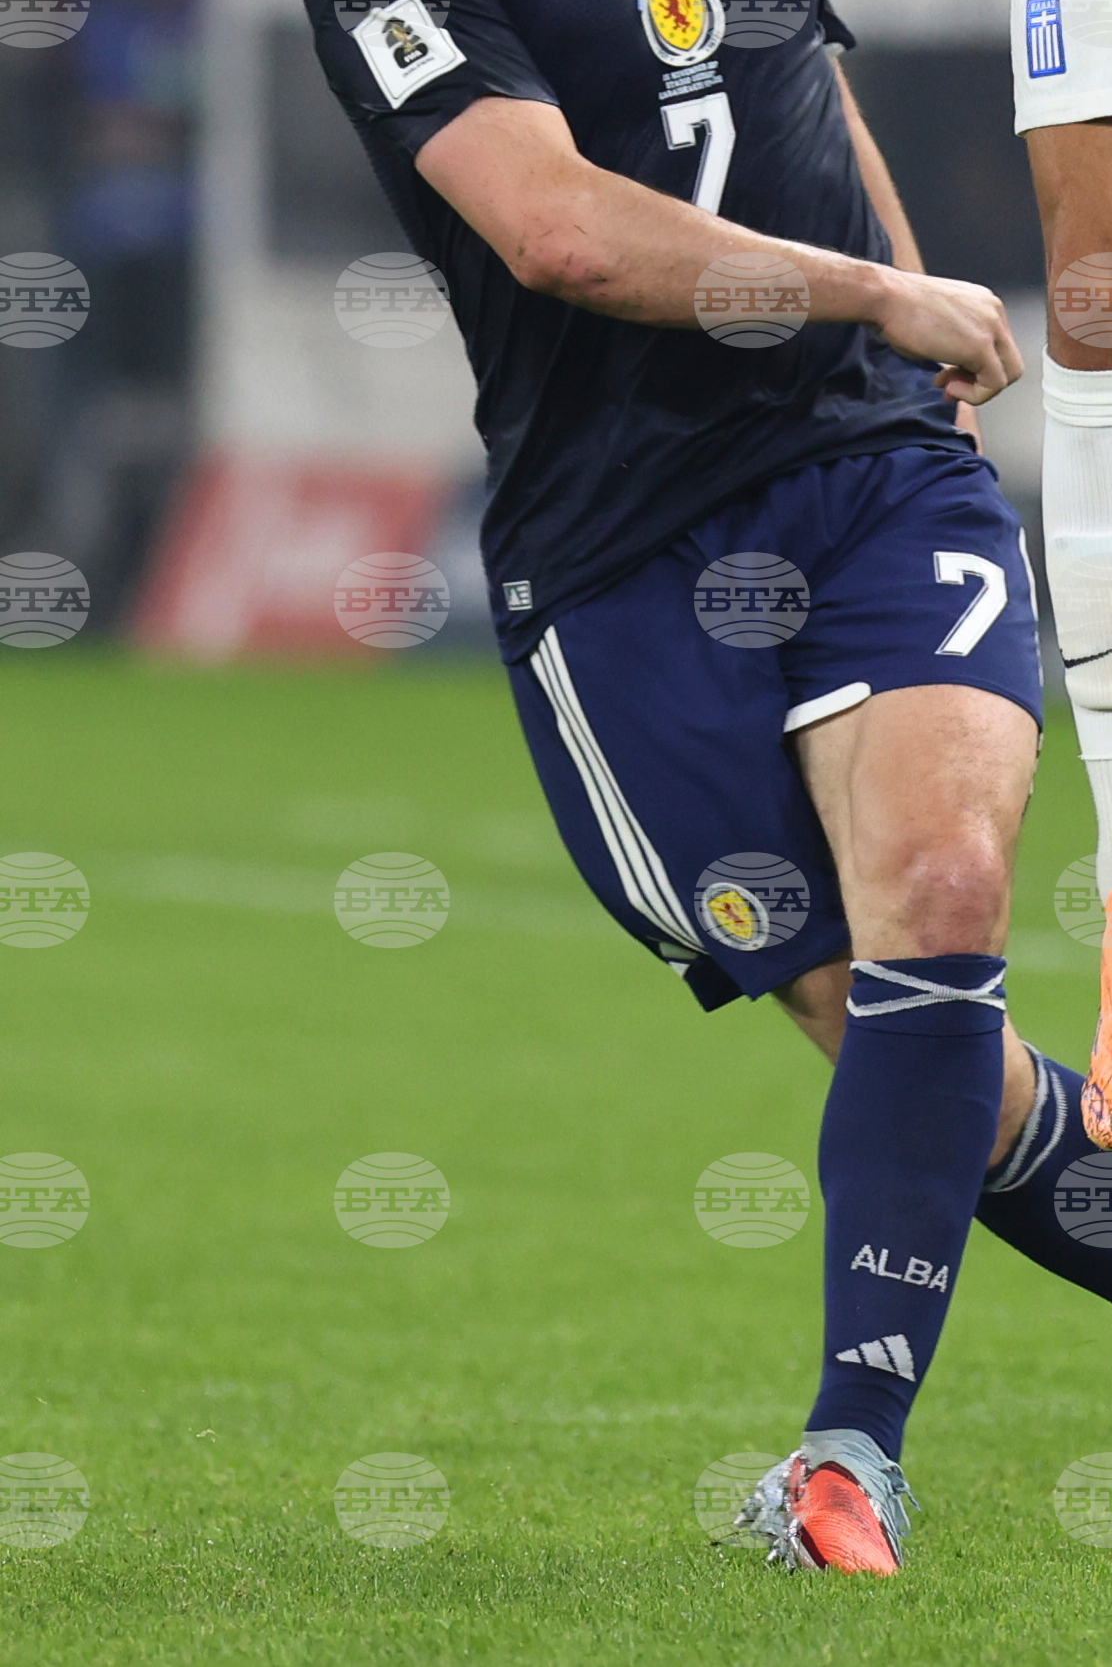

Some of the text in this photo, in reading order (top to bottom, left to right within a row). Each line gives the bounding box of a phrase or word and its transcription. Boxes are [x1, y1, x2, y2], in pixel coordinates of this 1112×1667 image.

[660, 92, 737, 216] 7
[933, 551, 1008, 657] 7
[850, 1244, 949, 1293] ALBA
